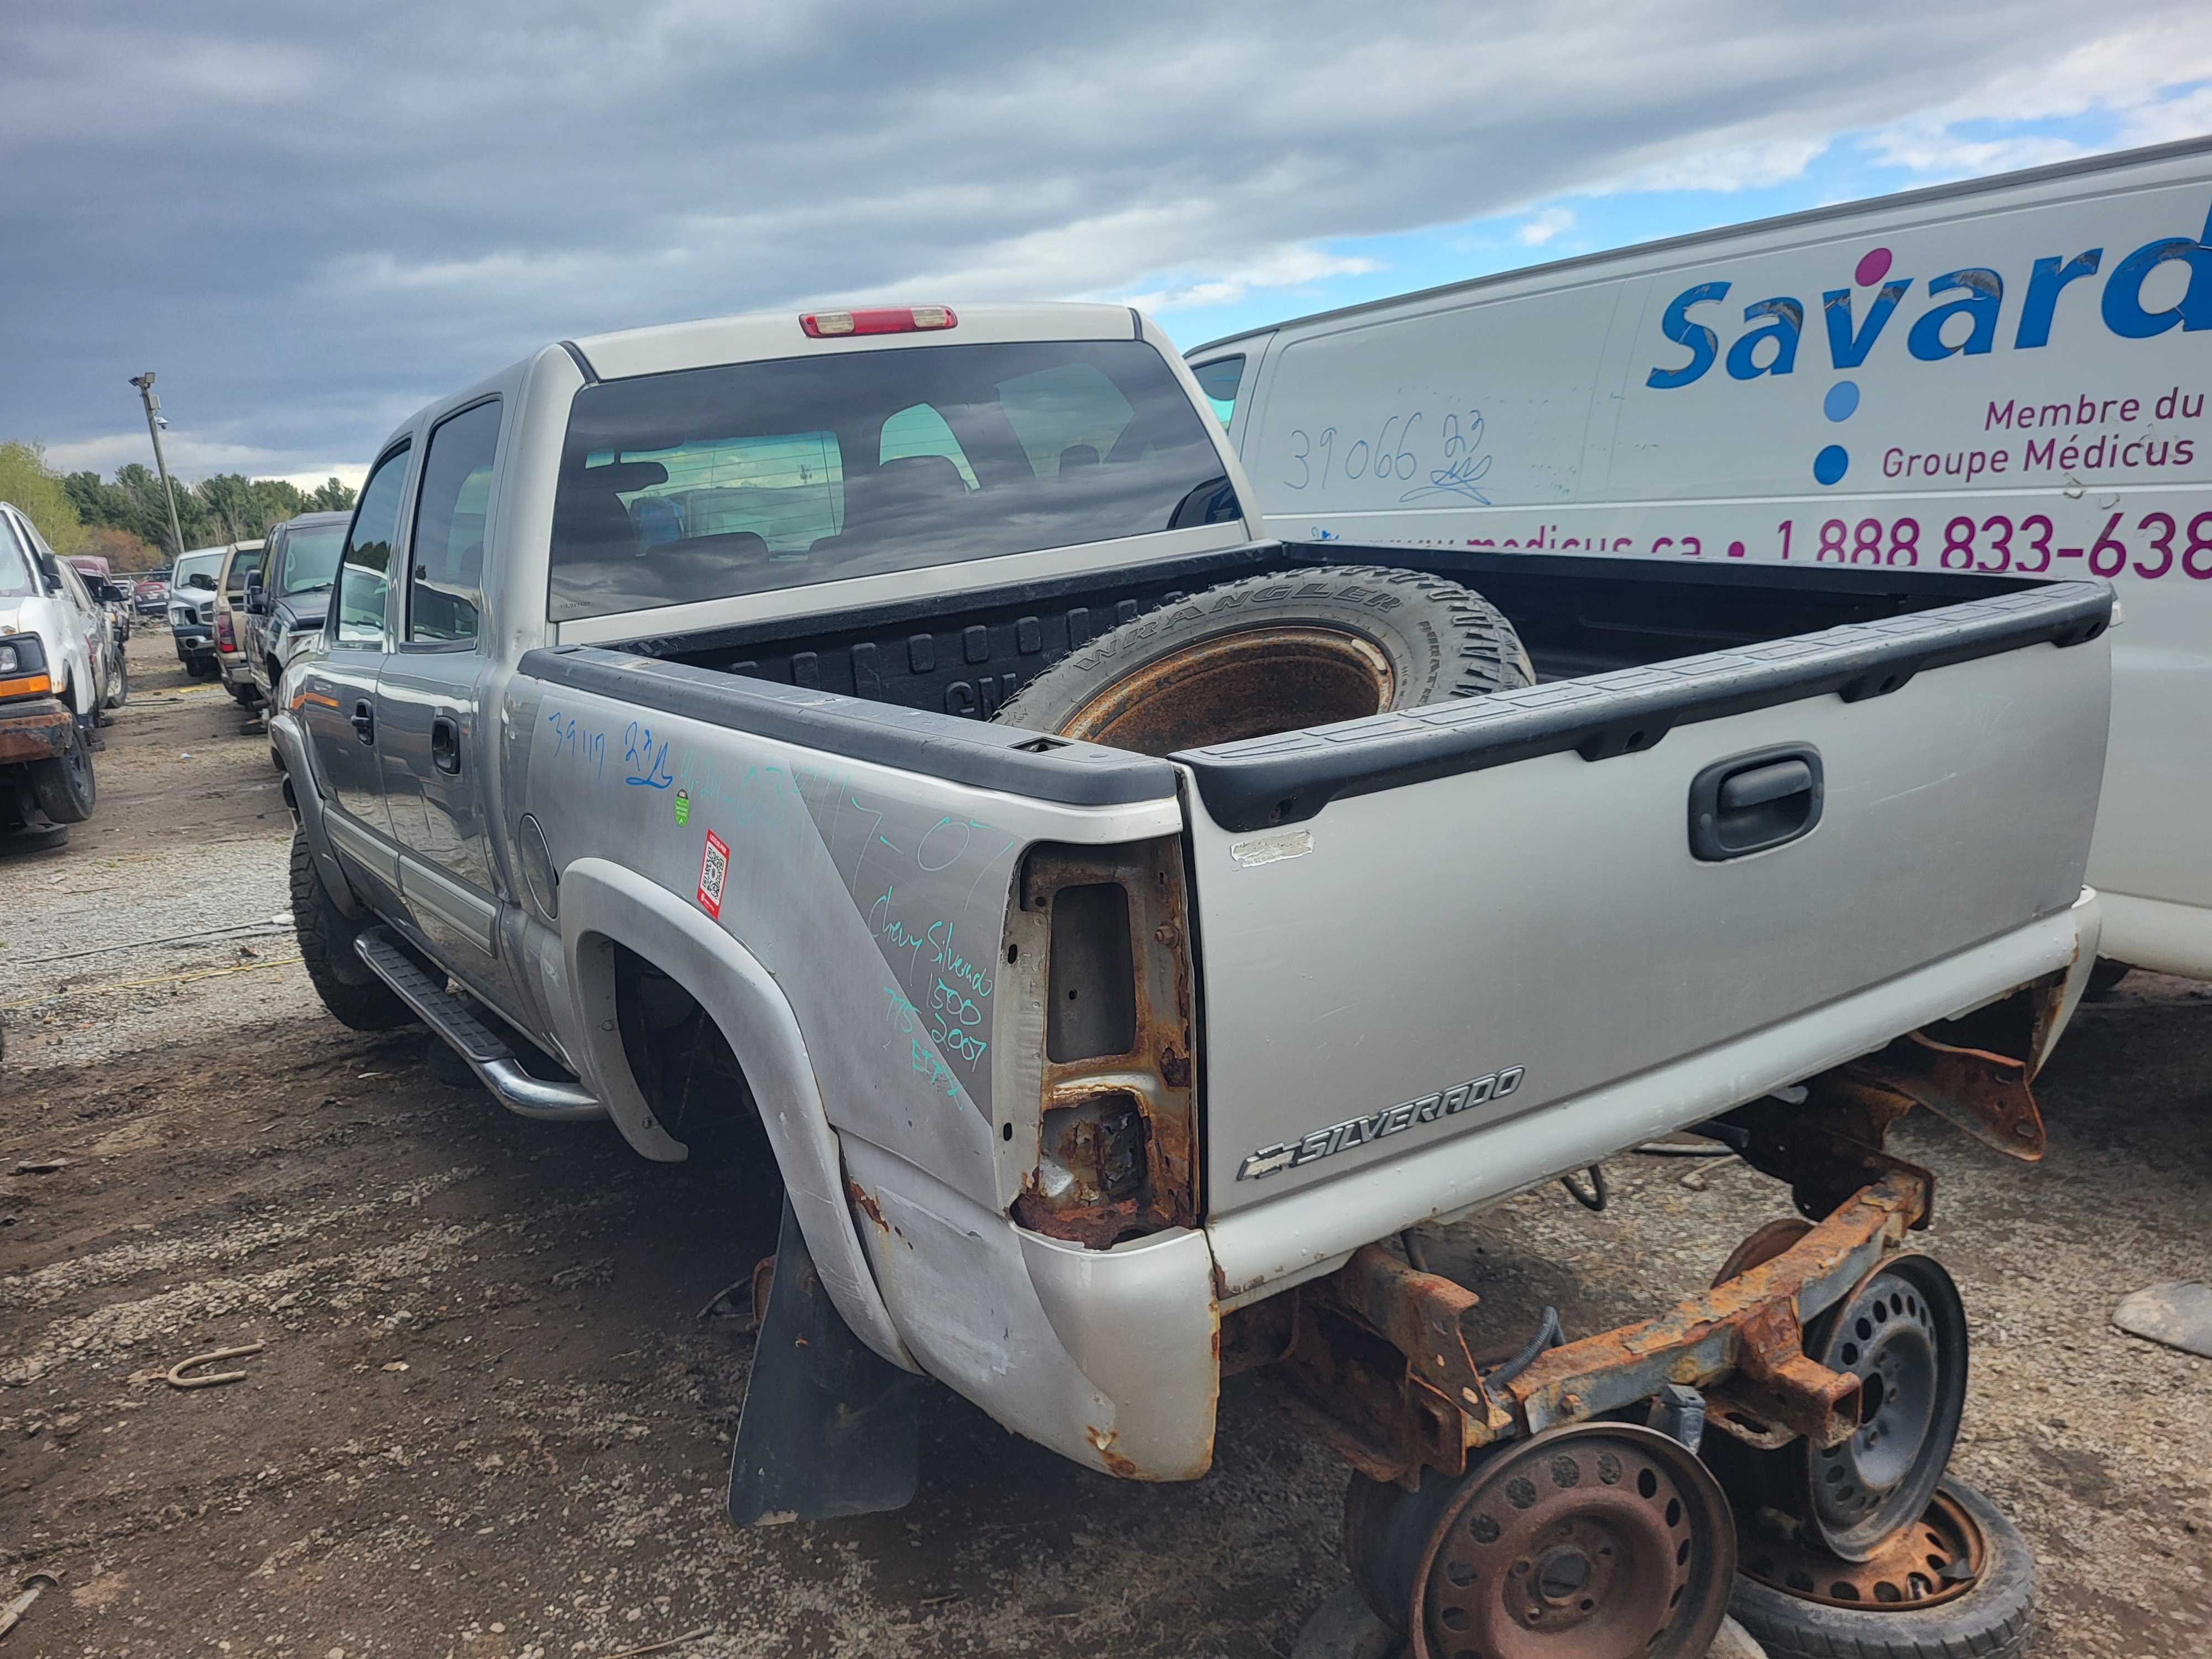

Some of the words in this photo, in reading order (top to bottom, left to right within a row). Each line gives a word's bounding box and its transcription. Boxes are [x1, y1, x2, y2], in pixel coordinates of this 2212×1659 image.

[1646, 199, 2212, 389] Savard
[1985, 394, 2139, 430] Membre
[2154, 387, 2204, 419] du
[1882, 447, 2009, 482] Groupe
[2023, 435, 2194, 471] Médicus
[1777, 520, 1793, 560] 1
[1816, 518, 1920, 566] 888
[1073, 582, 1404, 671] WRANGLER
[927, 972, 981, 1025] 1500
[931, 1013, 987, 1073] 2007
[1295, 1065, 1525, 1167] SILVERADO
